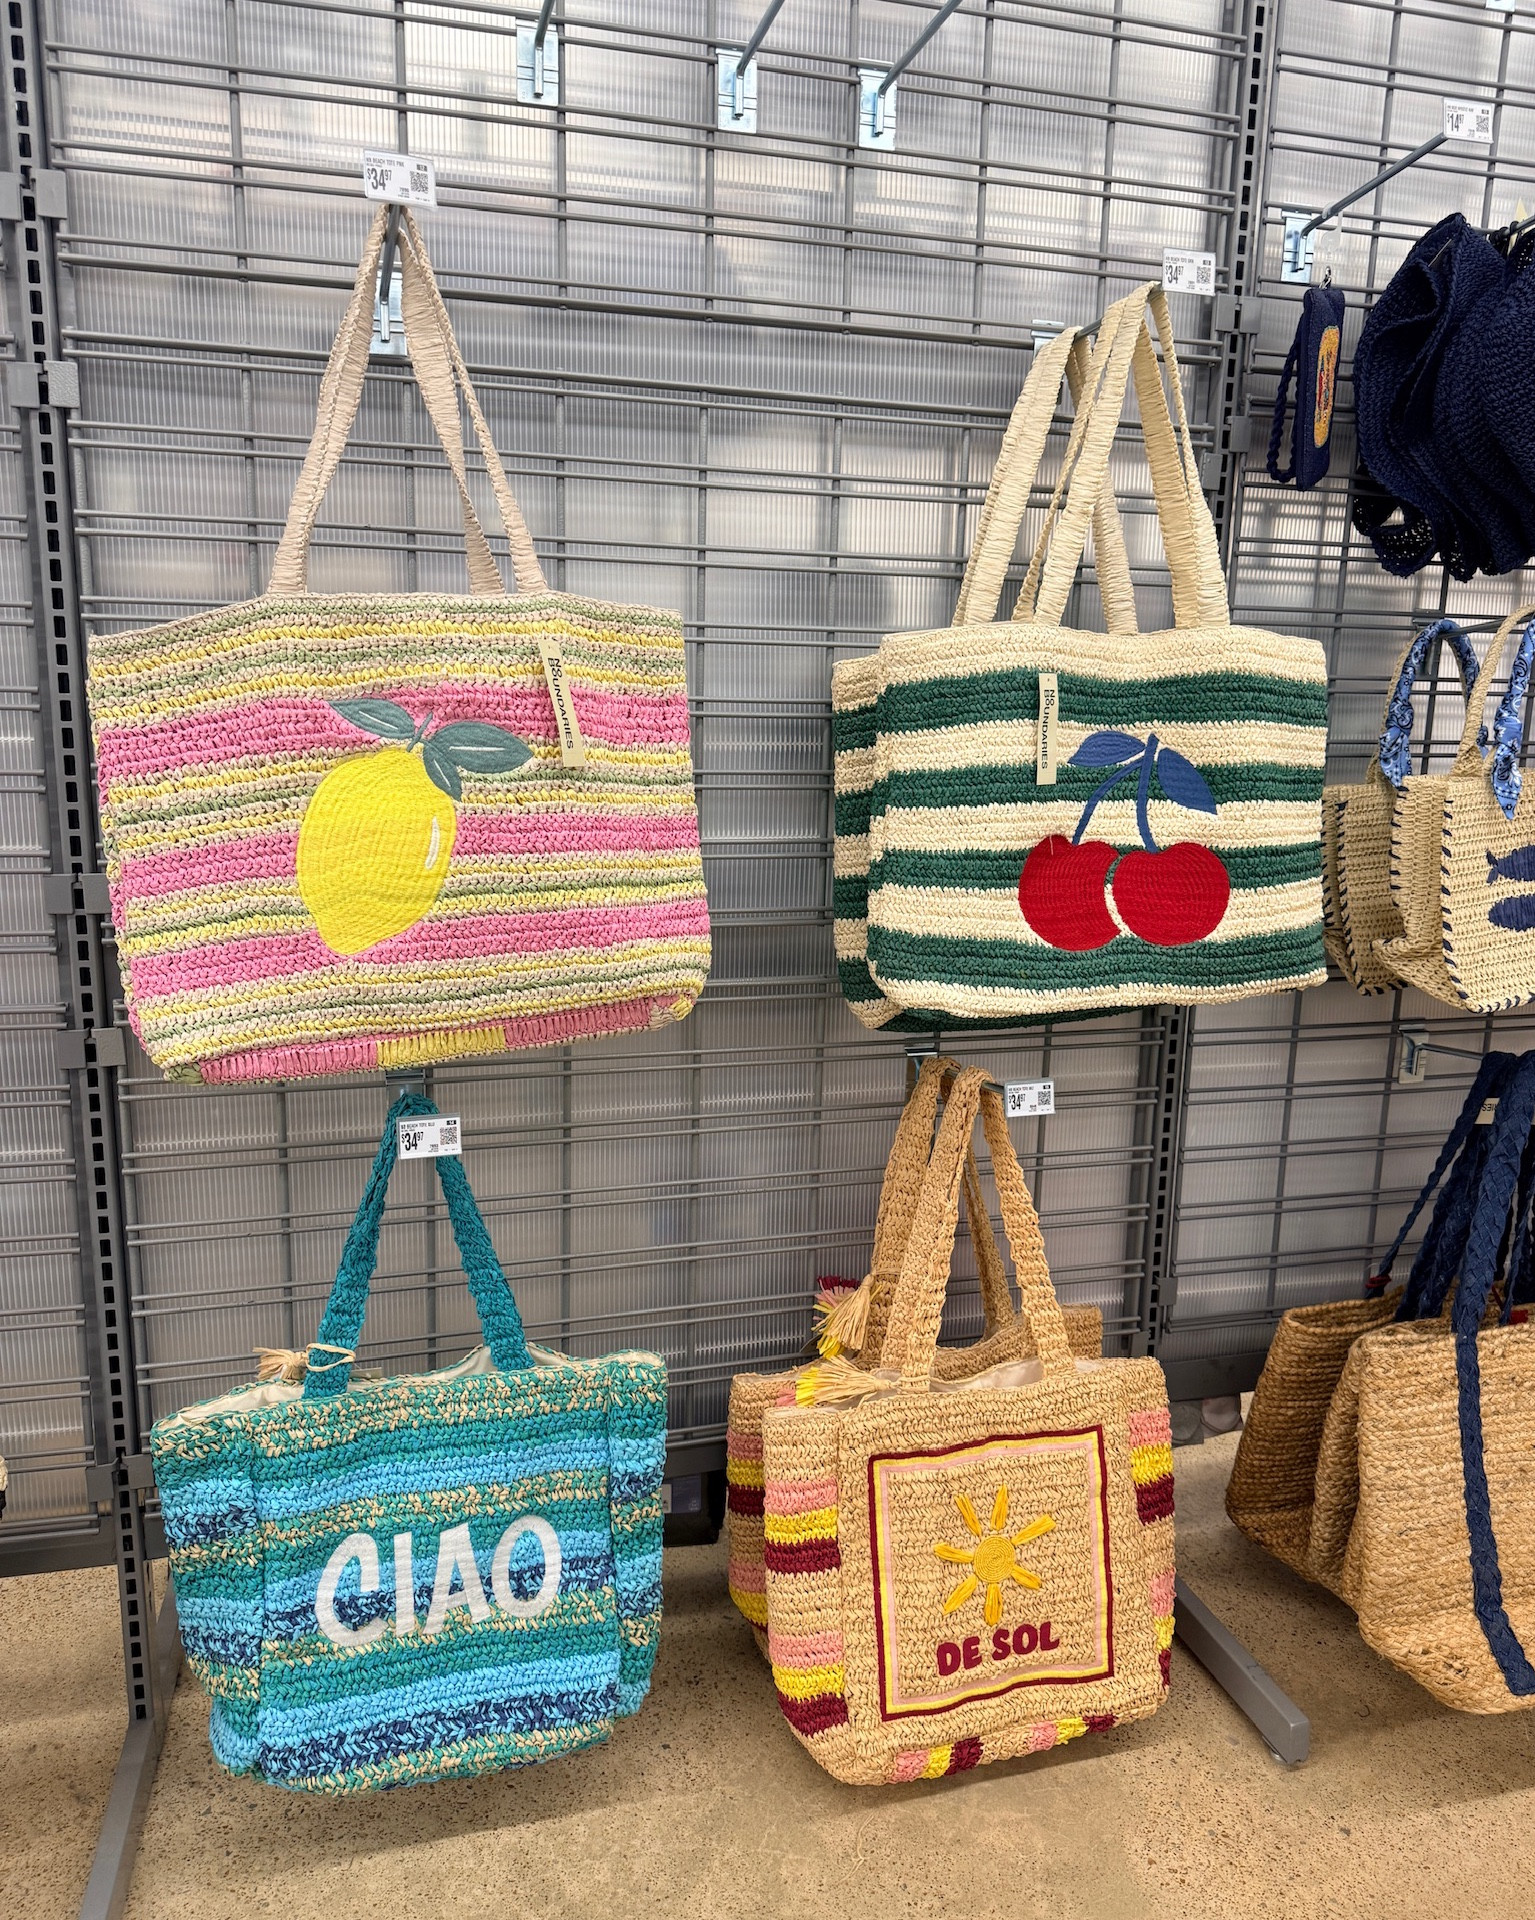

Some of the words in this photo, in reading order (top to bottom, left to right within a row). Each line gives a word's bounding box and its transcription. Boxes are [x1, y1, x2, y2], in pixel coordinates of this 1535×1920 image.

[547, 657, 574, 749] BOUNDARIES
[1041, 689, 1051, 770] BOUNDARIES
[314, 1515, 562, 1647] CIAO
[937, 1636, 982, 1676] DE
[992, 1621, 1060, 1661] SOL
